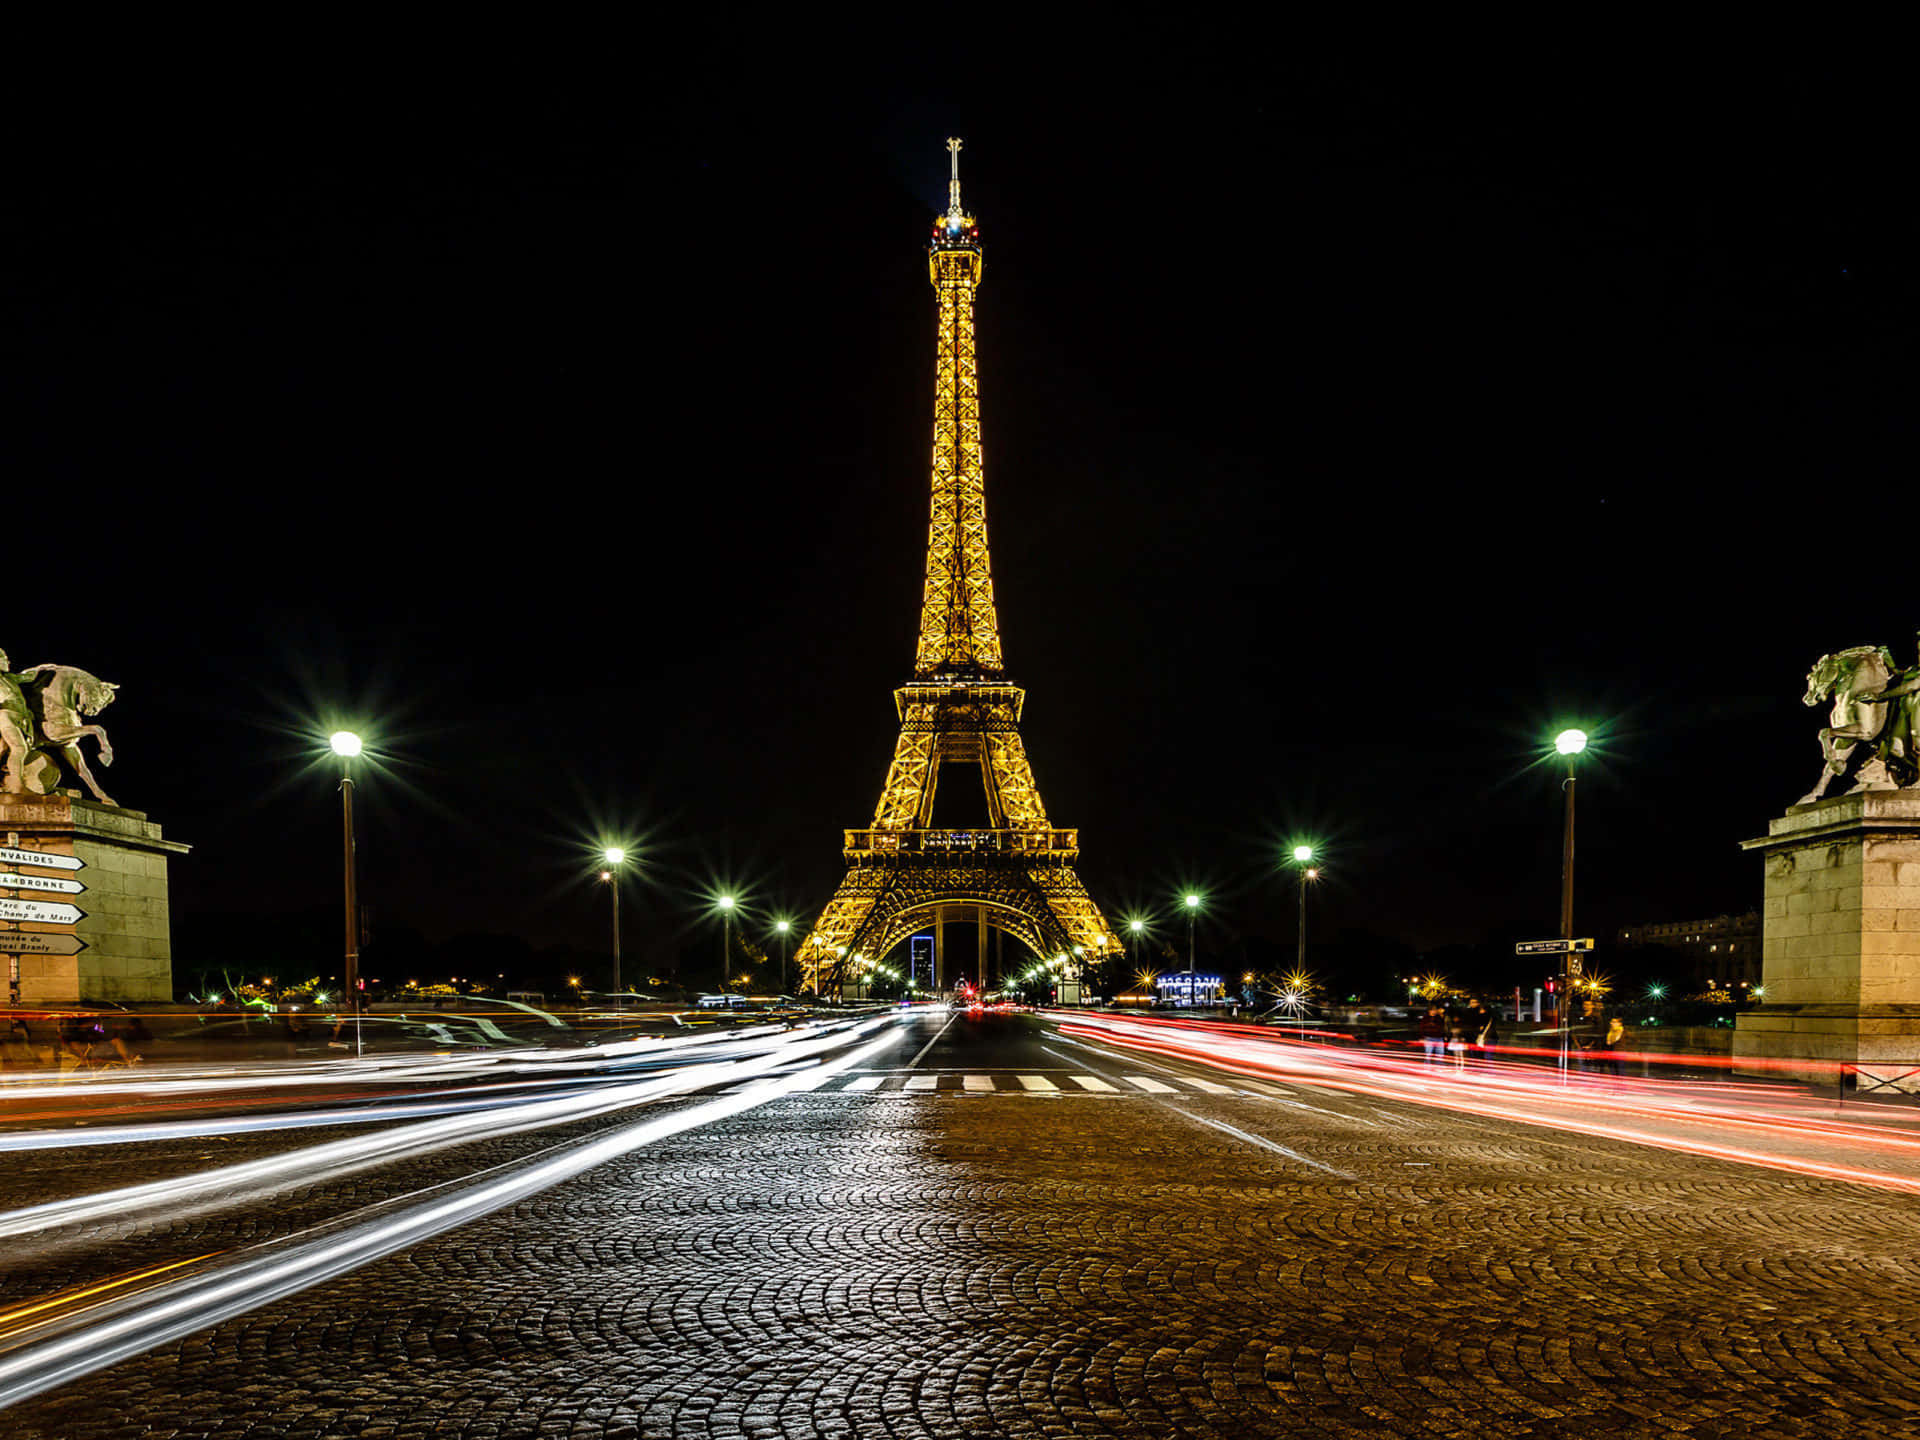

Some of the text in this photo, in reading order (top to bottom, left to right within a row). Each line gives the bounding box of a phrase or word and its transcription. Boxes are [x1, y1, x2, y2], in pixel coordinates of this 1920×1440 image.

[0, 851, 54, 864] NVALIDES
[0, 876, 64, 889] AMBRONNE
[25, 903, 37, 911] du
[49, 913, 72, 921] Mars
